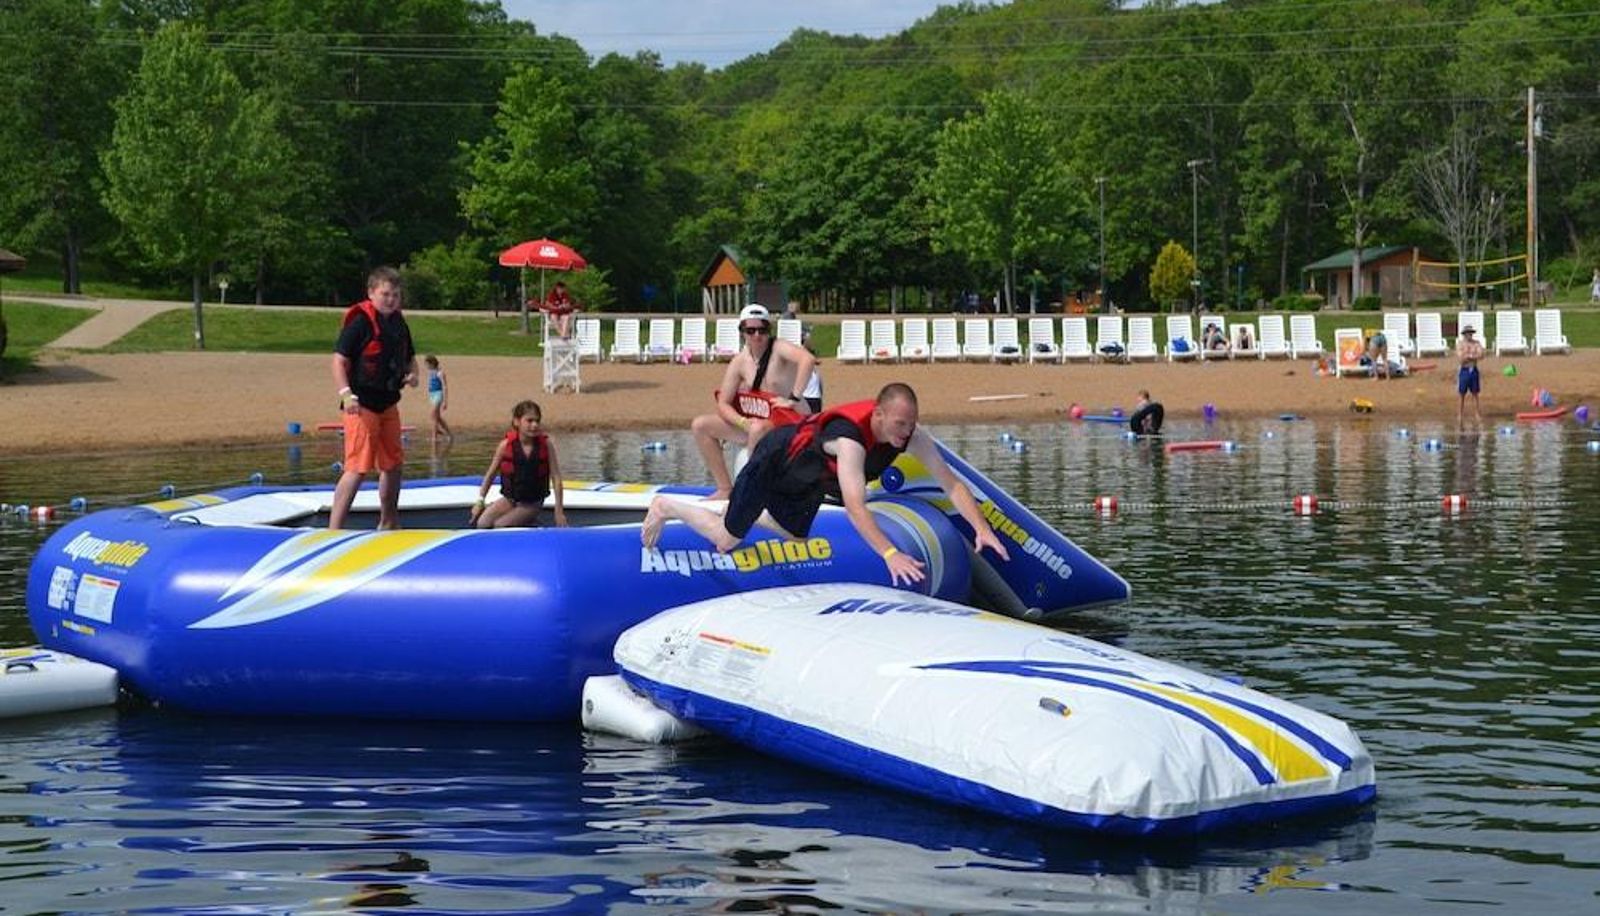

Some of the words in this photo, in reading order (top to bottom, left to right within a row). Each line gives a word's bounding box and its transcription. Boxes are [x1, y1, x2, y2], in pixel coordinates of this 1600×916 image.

[739, 395, 770, 418] GUARD
[62, 530, 149, 568] Aquaglide
[640, 538, 832, 577] Aquaglide
[978, 499, 1073, 579] Aquaglide
